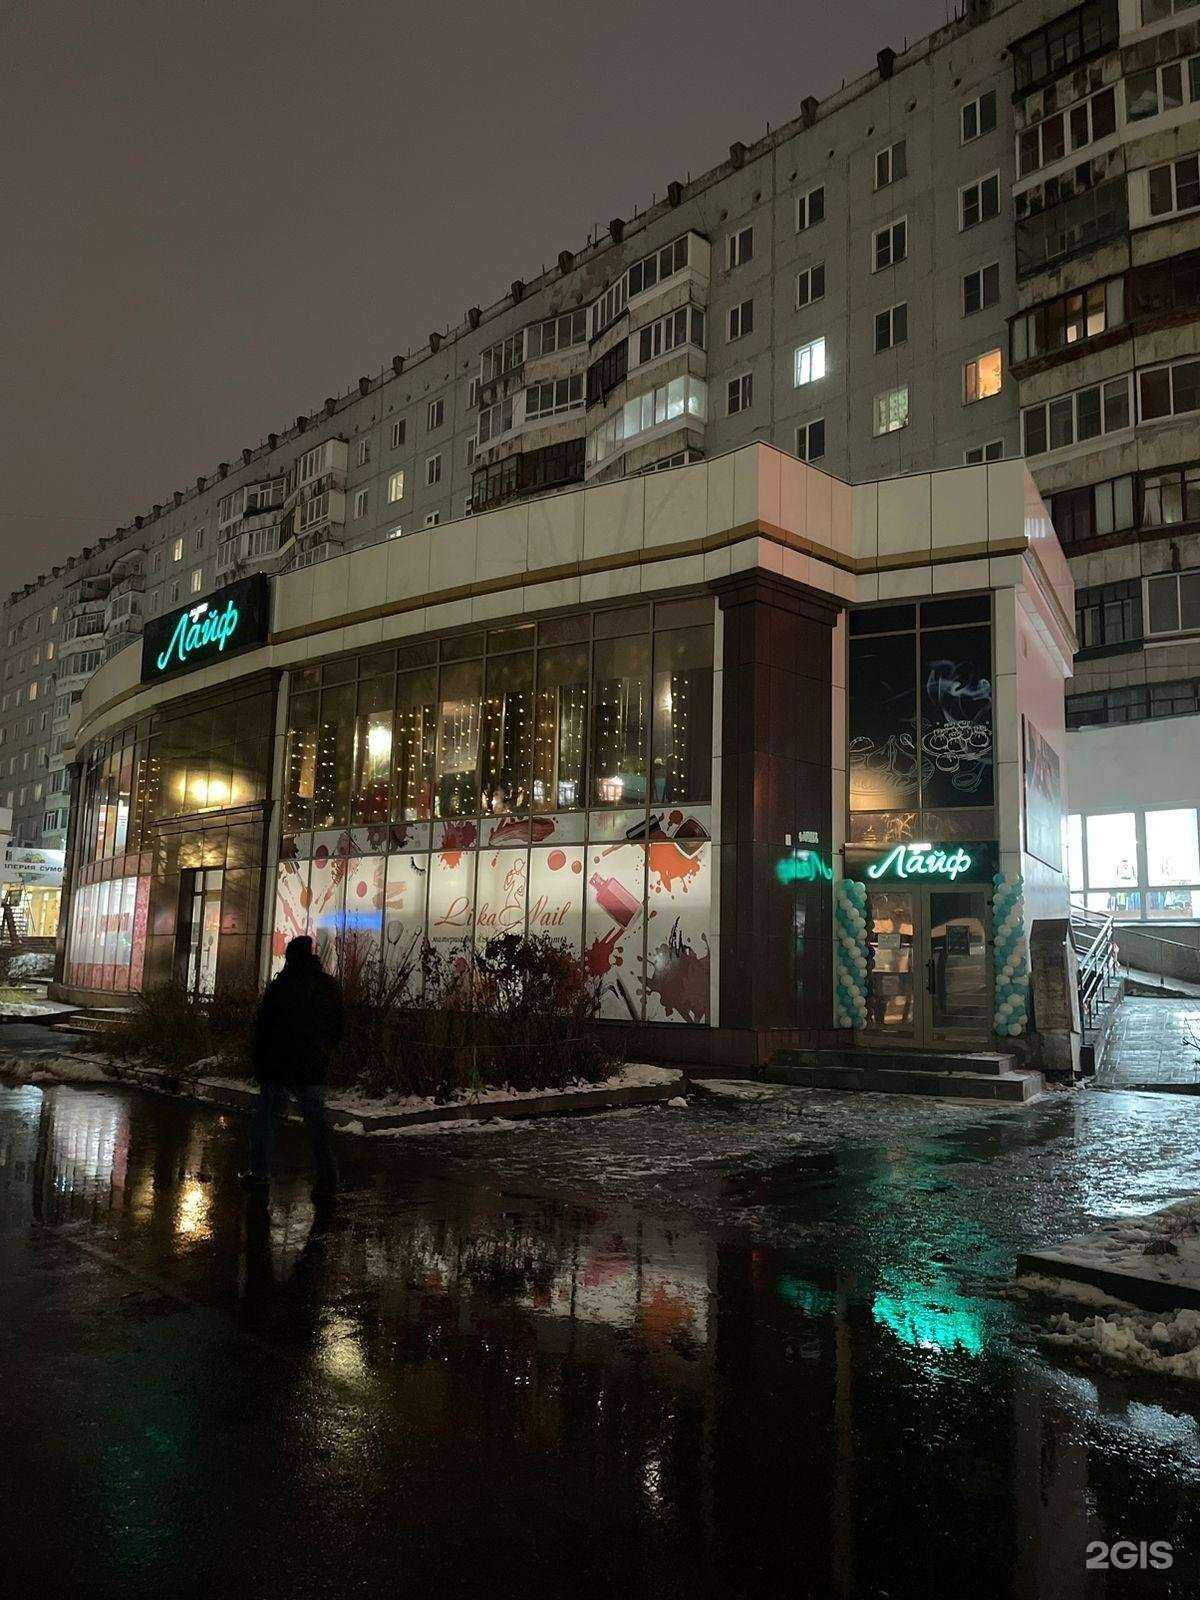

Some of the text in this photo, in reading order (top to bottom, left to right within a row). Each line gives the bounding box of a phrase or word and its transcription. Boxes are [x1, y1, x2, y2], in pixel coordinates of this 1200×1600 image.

[157, 600, 238, 670] Лайф
[867, 846, 972, 881] Лайф
[434, 896, 497, 927] Lika
